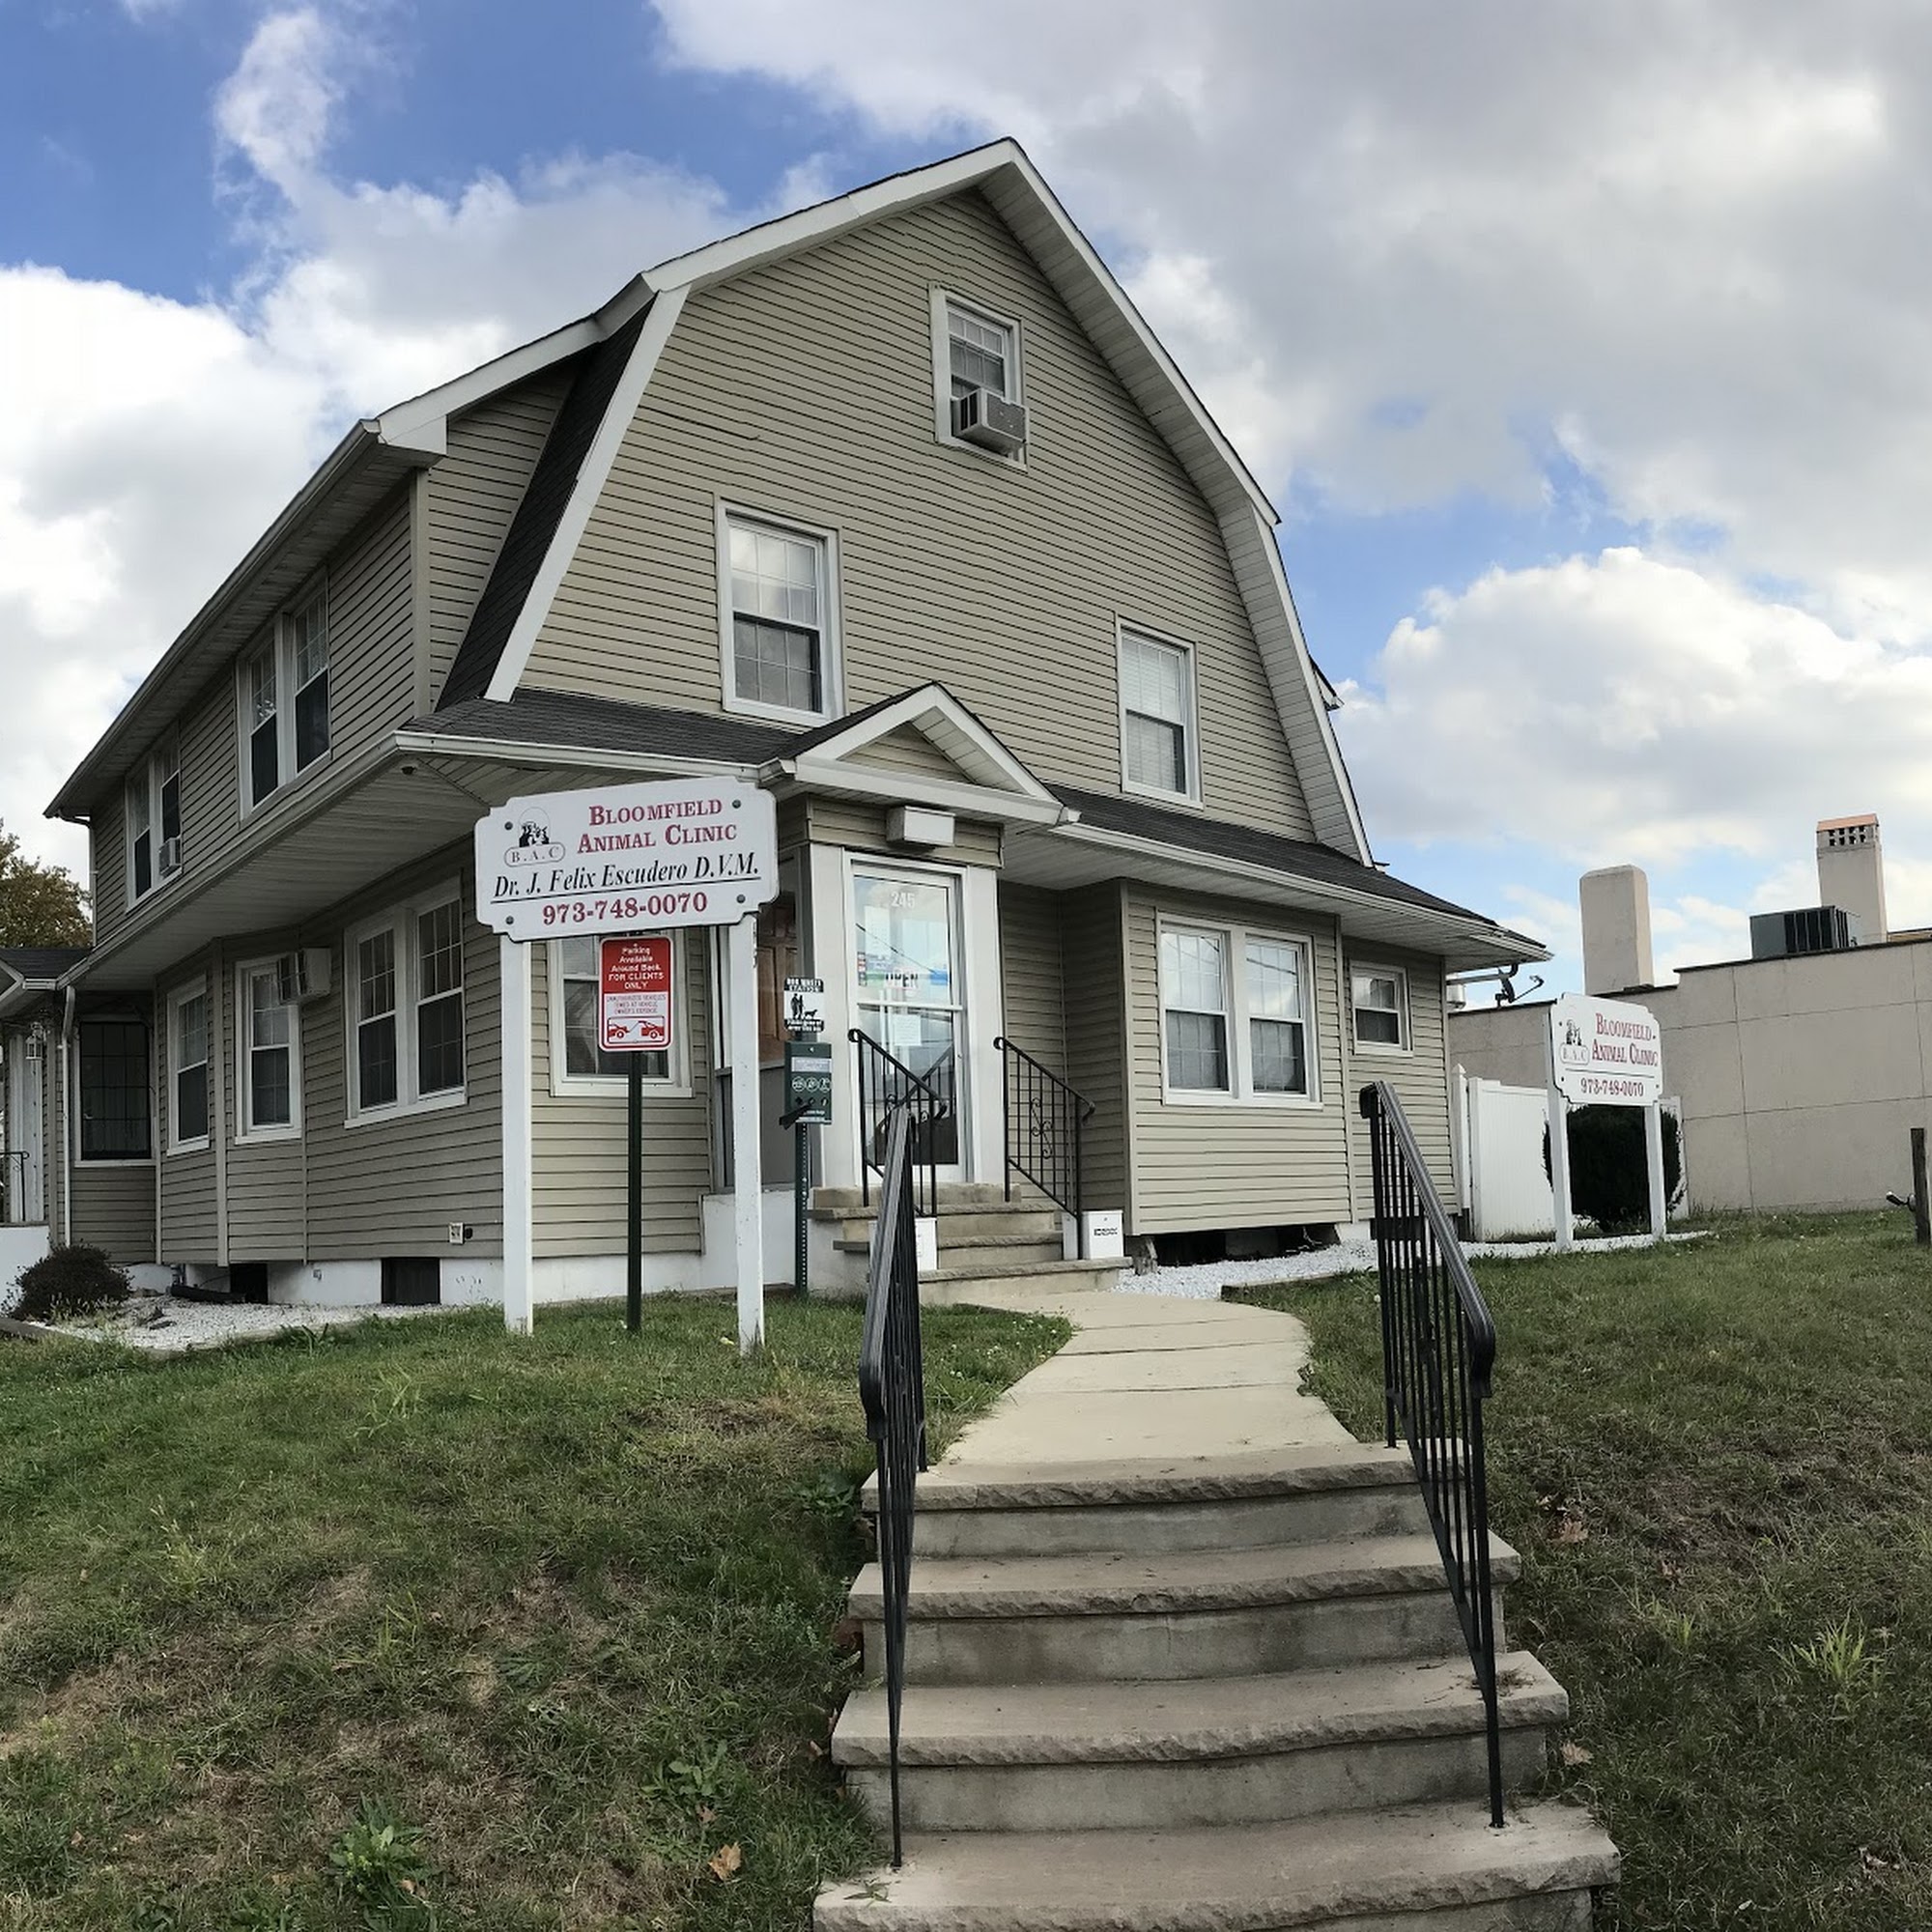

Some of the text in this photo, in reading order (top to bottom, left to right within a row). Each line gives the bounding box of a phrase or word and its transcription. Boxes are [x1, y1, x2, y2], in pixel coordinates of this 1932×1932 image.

[588, 799, 723, 826] BLOOMFIELD
[577, 824, 737, 854] ANIMAL CLINIC
[494, 852, 758, 897] Dr. J. Felix Escudero D.V.M.
[543, 892, 708, 925] 973-748-0070
